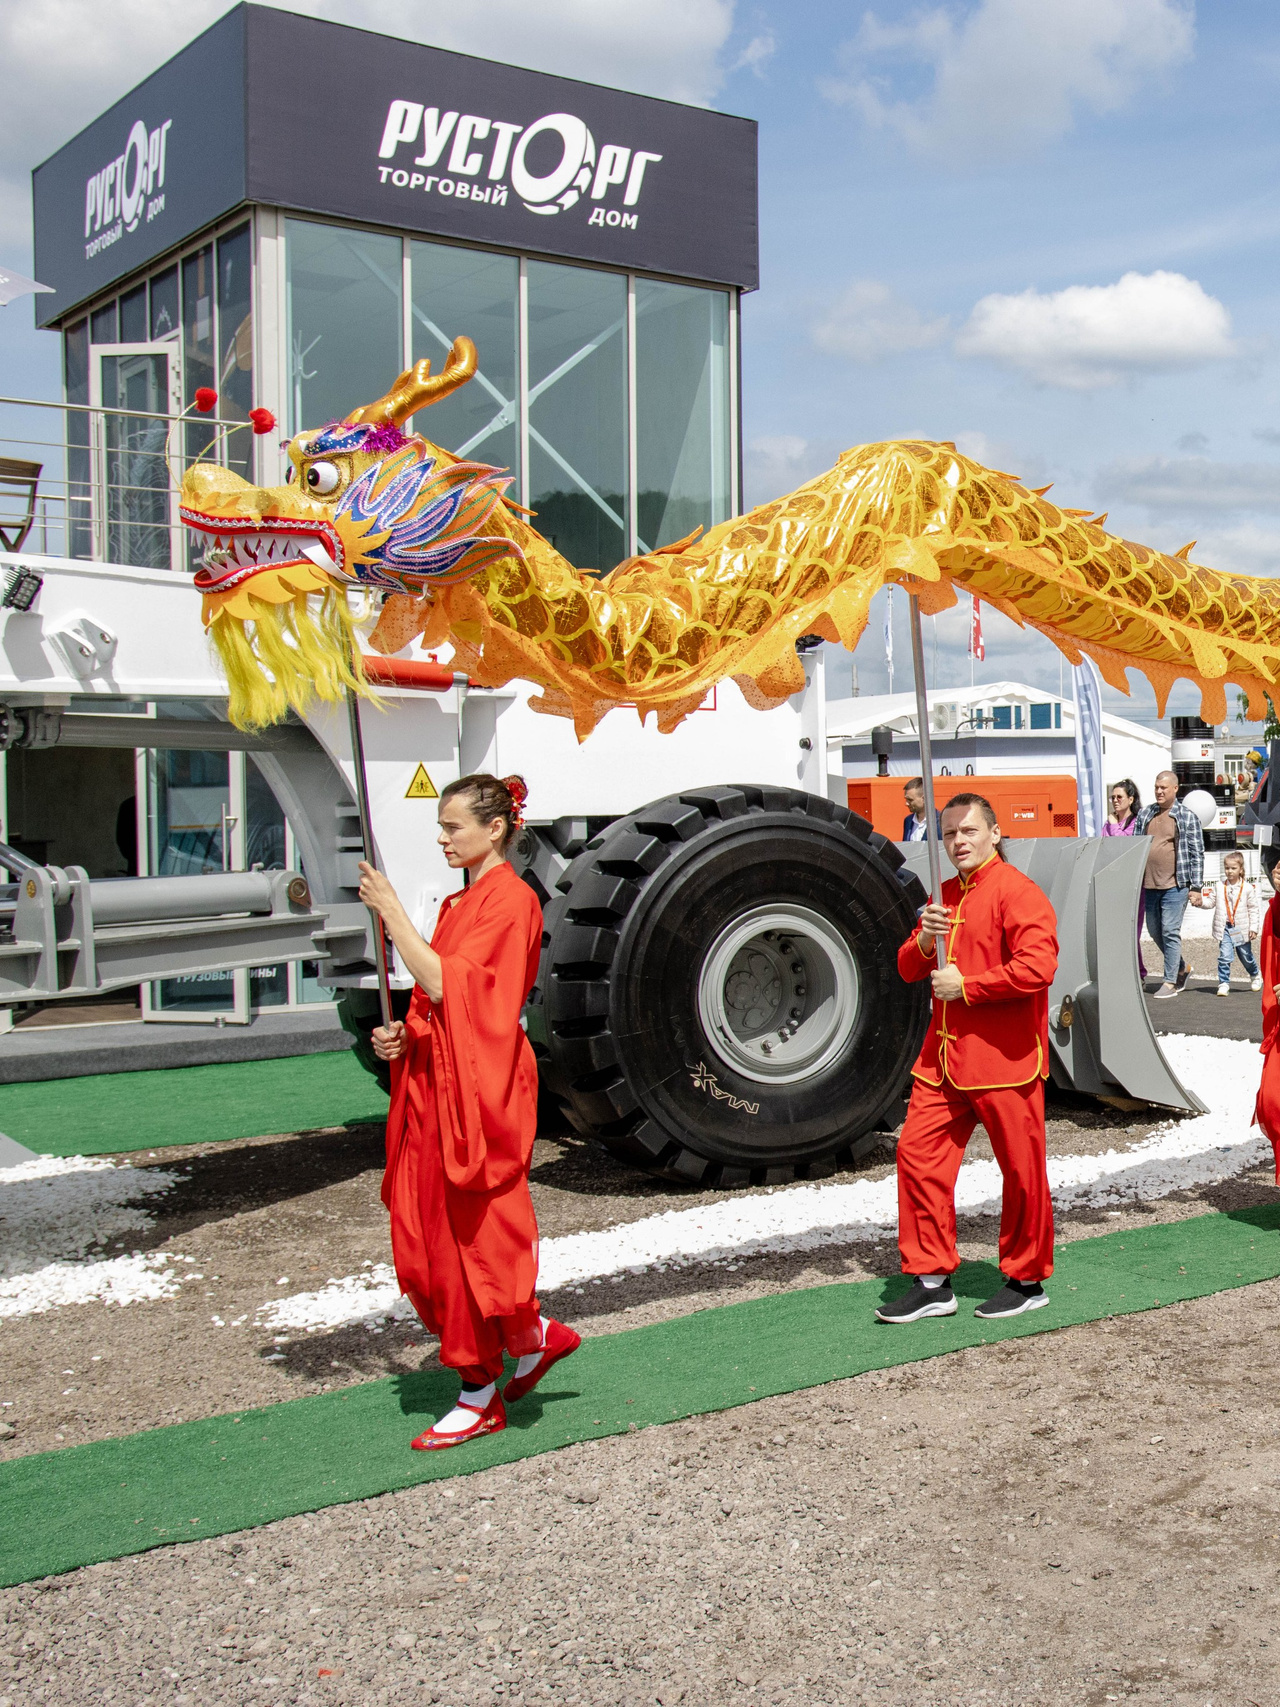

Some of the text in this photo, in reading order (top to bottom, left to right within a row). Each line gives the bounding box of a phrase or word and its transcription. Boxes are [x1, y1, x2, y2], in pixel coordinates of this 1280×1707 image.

[85, 119, 173, 238] РУСТОРГ
[377, 99, 663, 215] РУСТОРГ
[377, 166, 639, 230] ТОРГОВЫЙ ДОМ
[85, 194, 165, 260] ТОРГОВЫЙ ДОМ
